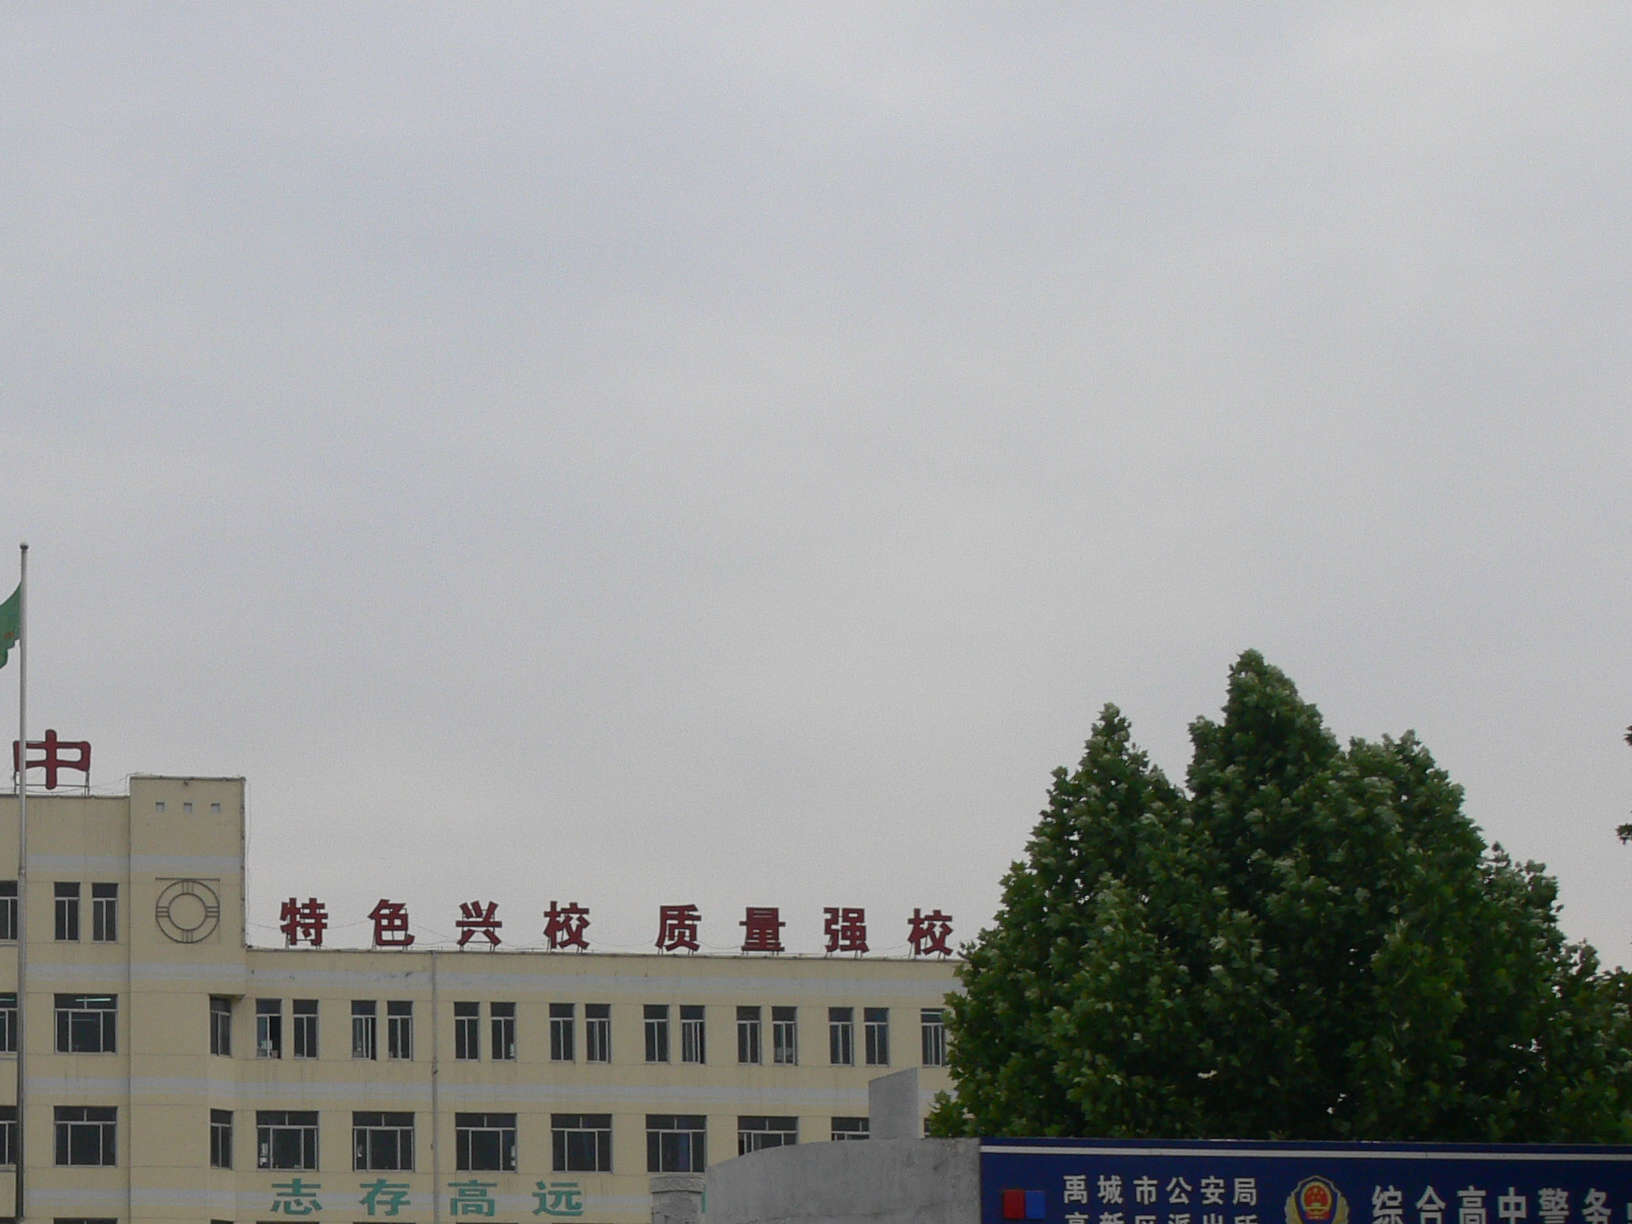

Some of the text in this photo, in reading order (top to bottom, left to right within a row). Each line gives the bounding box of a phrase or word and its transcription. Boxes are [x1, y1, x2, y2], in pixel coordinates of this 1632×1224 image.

[279, 898, 953, 956] 特色兴校 质量强校
[270, 1178, 585, 1217] 志存高远
[1063, 1174, 1258, 1206] 禹城市公安局
